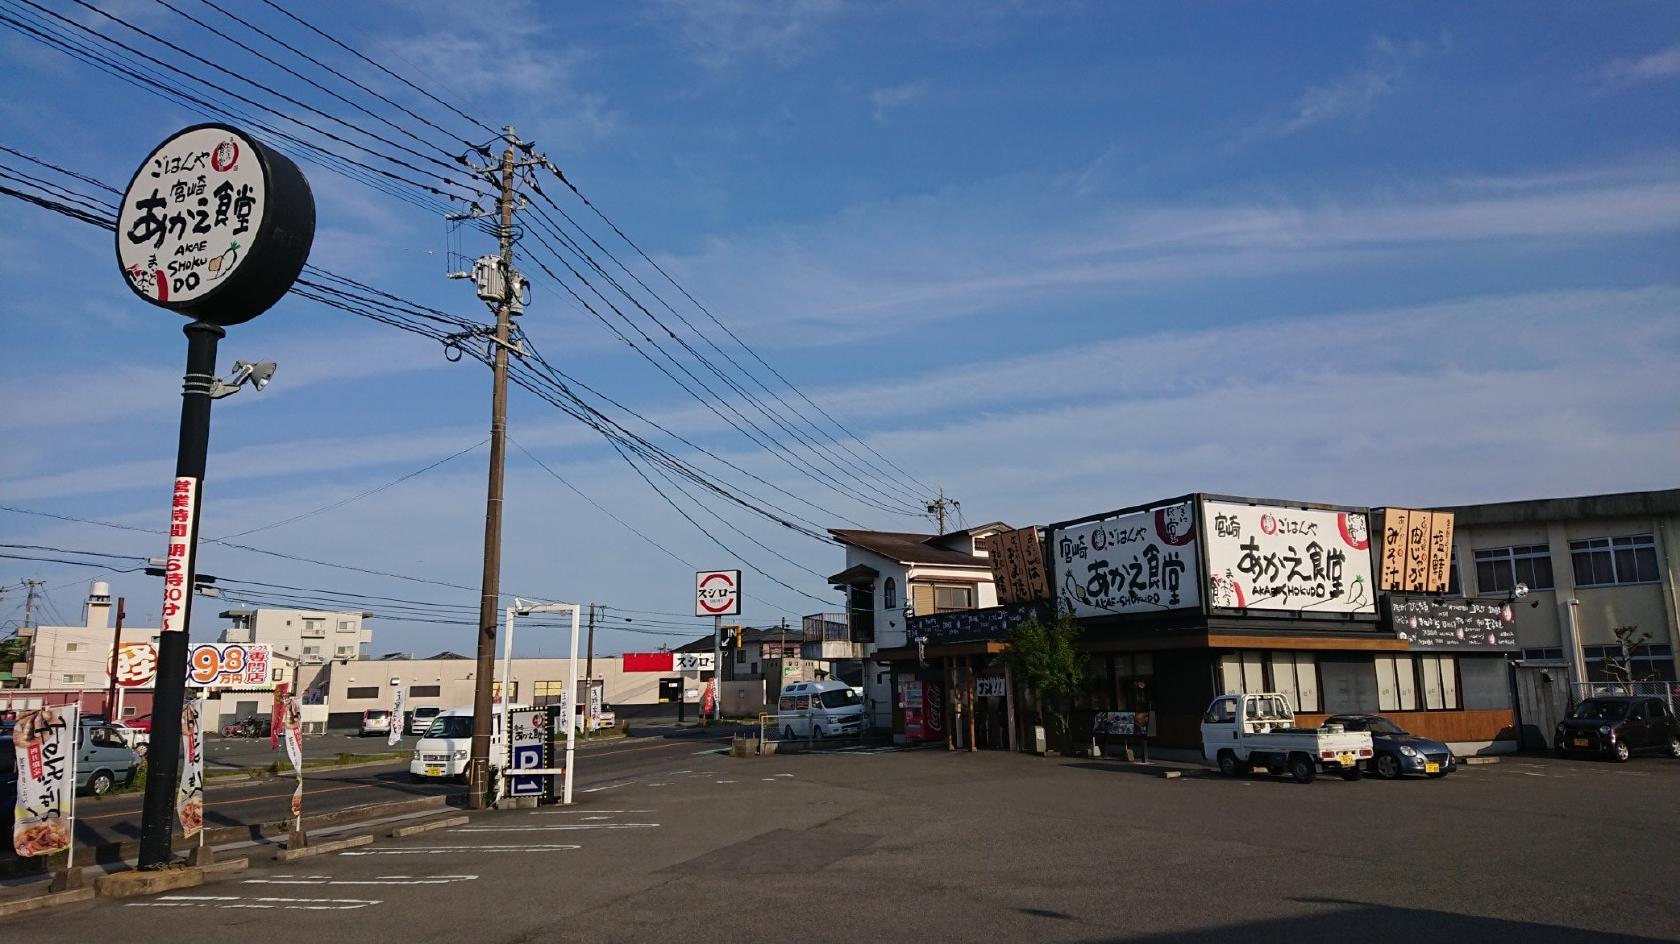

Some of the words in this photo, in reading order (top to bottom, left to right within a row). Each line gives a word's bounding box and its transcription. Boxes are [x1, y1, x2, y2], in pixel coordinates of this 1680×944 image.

[151, 151, 210, 178] ごはんや
[170, 175, 207, 203] 宮崎
[127, 180, 257, 249] あかえ食堂
[174, 241, 208, 257] AKAE
[167, 257, 208, 278] SHOKU
[173, 272, 200, 293] DO
[171, 480, 192, 537] 営業時間
[1108, 527, 1147, 546] ごはんや
[1215, 512, 1240, 539] 宮崎
[1278, 517, 1318, 536] ごはんや
[1060, 535, 1088, 563] 宮崎
[1386, 527, 1399, 583] みそ汁
[1408, 525, 1426, 584] 肉じゃが
[1086, 543, 1186, 605] あかえ食堂
[1237, 535, 1346, 599] あかえ食堂
[698, 588, 736, 599] スシロー
[727, 629, 737, 638] IN
[219, 673, 243, 684] 万円
[246, 651, 267, 683] 専門店
[521, 751, 539, 769] P
